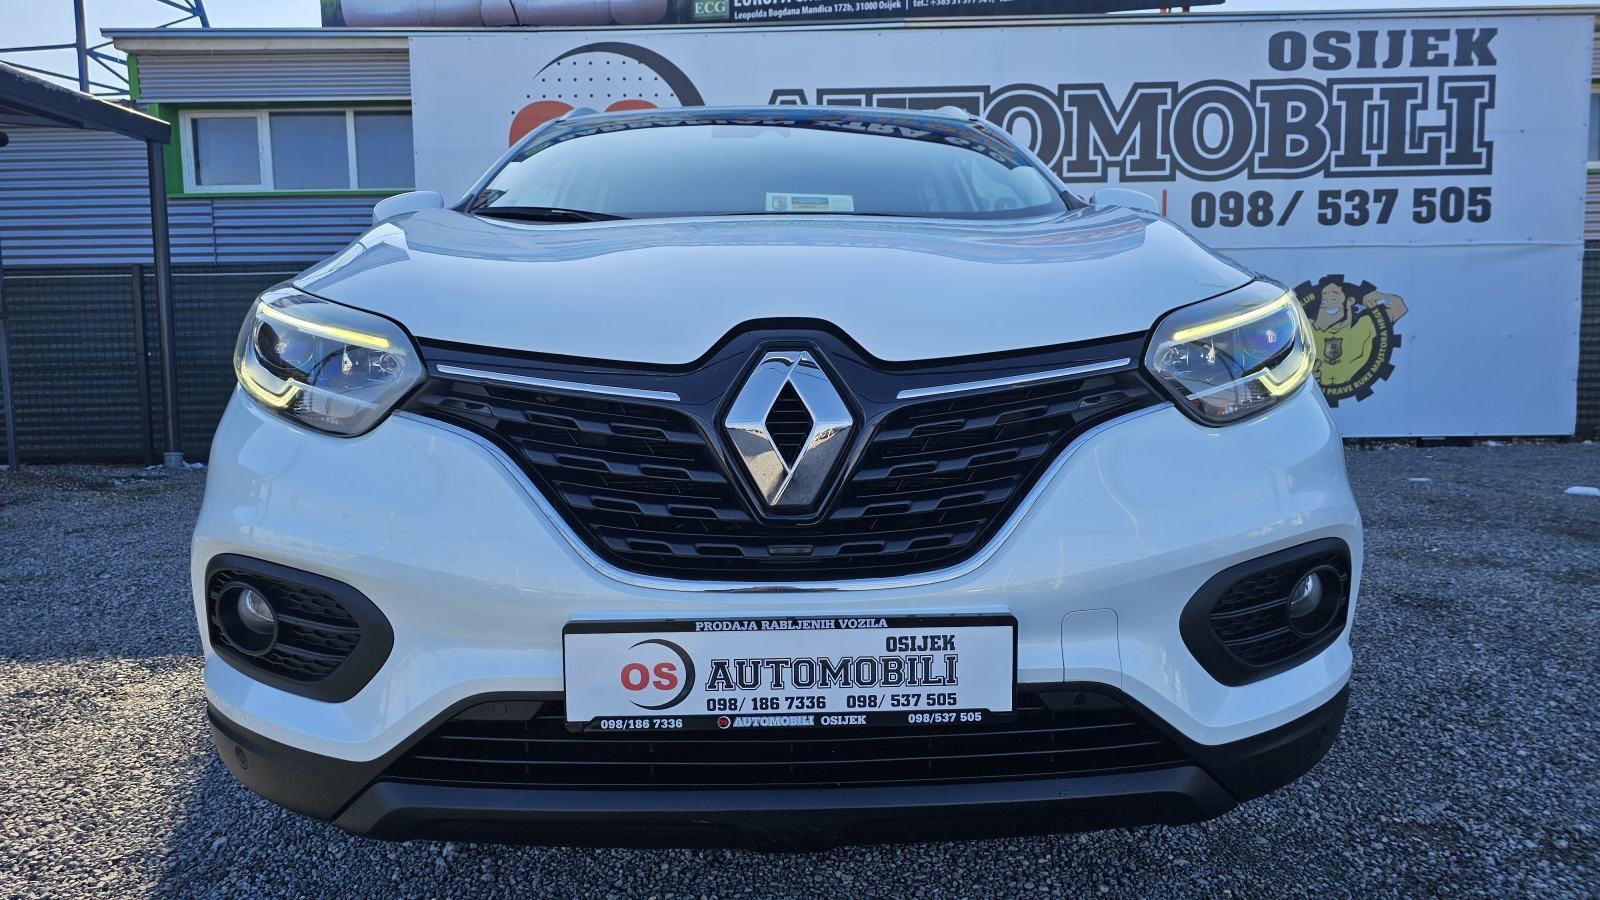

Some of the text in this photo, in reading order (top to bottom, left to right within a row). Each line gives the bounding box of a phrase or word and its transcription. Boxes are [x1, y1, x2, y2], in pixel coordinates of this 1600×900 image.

[695, 1, 726, 14] ECG
[734, 10, 767, 20] Leopolda
[768, 8, 800, 18] Bogdana
[855, 2, 878, 11] 31000
[879, 0, 902, 10] Osijek
[1268, 28, 1498, 71] OSIJEK
[768, 75, 1496, 182] OMOBILI
[1191, 186, 1492, 228] 098/ 537 505
[695, 618, 888, 632] PRODAJA RABLJENIH VOZILA
[885, 634, 956, 653] OSIJEK
[620, 662, 678, 691] OS
[705, 653, 958, 691] AUTOMOBILI
[706, 695, 827, 712] 098/ 186 7336
[846, 692, 957, 709] 098/ 537 505
[600, 718, 683, 730] 098/186 7336
[733, 715, 815, 728] AUTOMOBILI
[820, 715, 867, 727] OSIJEK
[907, 712, 982, 724] 098/537 505
